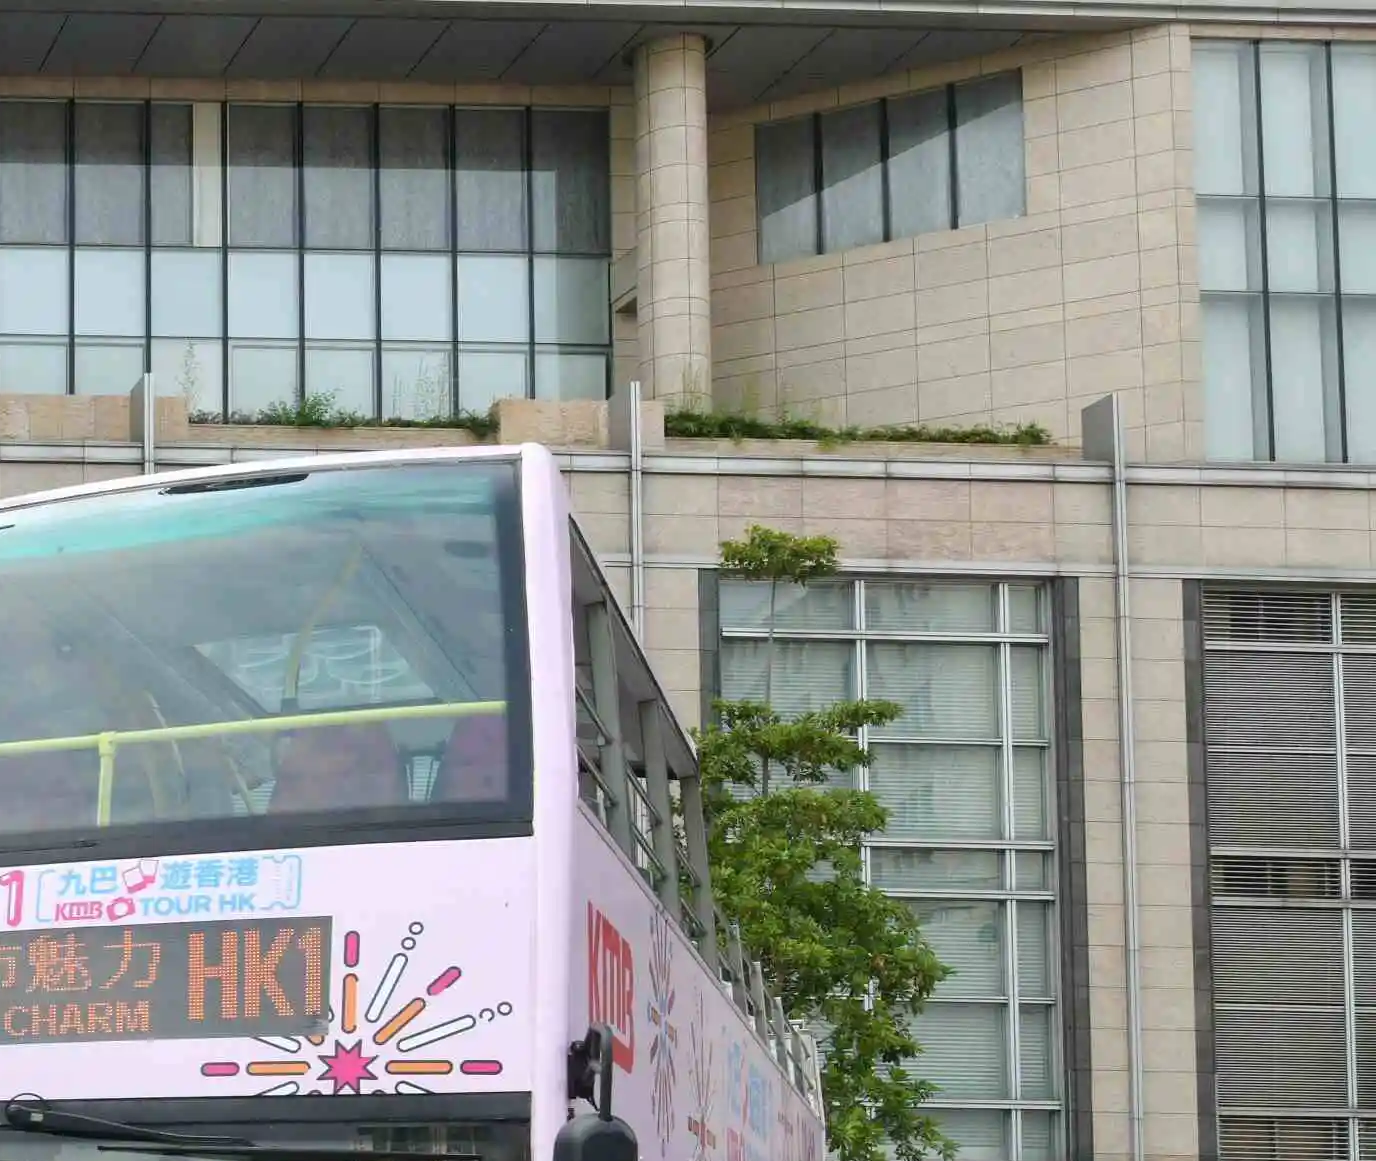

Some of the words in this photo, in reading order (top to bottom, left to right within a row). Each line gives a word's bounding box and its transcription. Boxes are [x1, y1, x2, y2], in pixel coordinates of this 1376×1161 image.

[57, 865, 119, 897] 九巴
[161, 857, 260, 890] 遊香港
[53, 900, 104, 922] KMB
[139, 895, 212, 918] TOUR
[218, 891, 256, 913] HK
[186, 926, 323, 1021] HK1
[3, 1001, 150, 1038] CHARM
